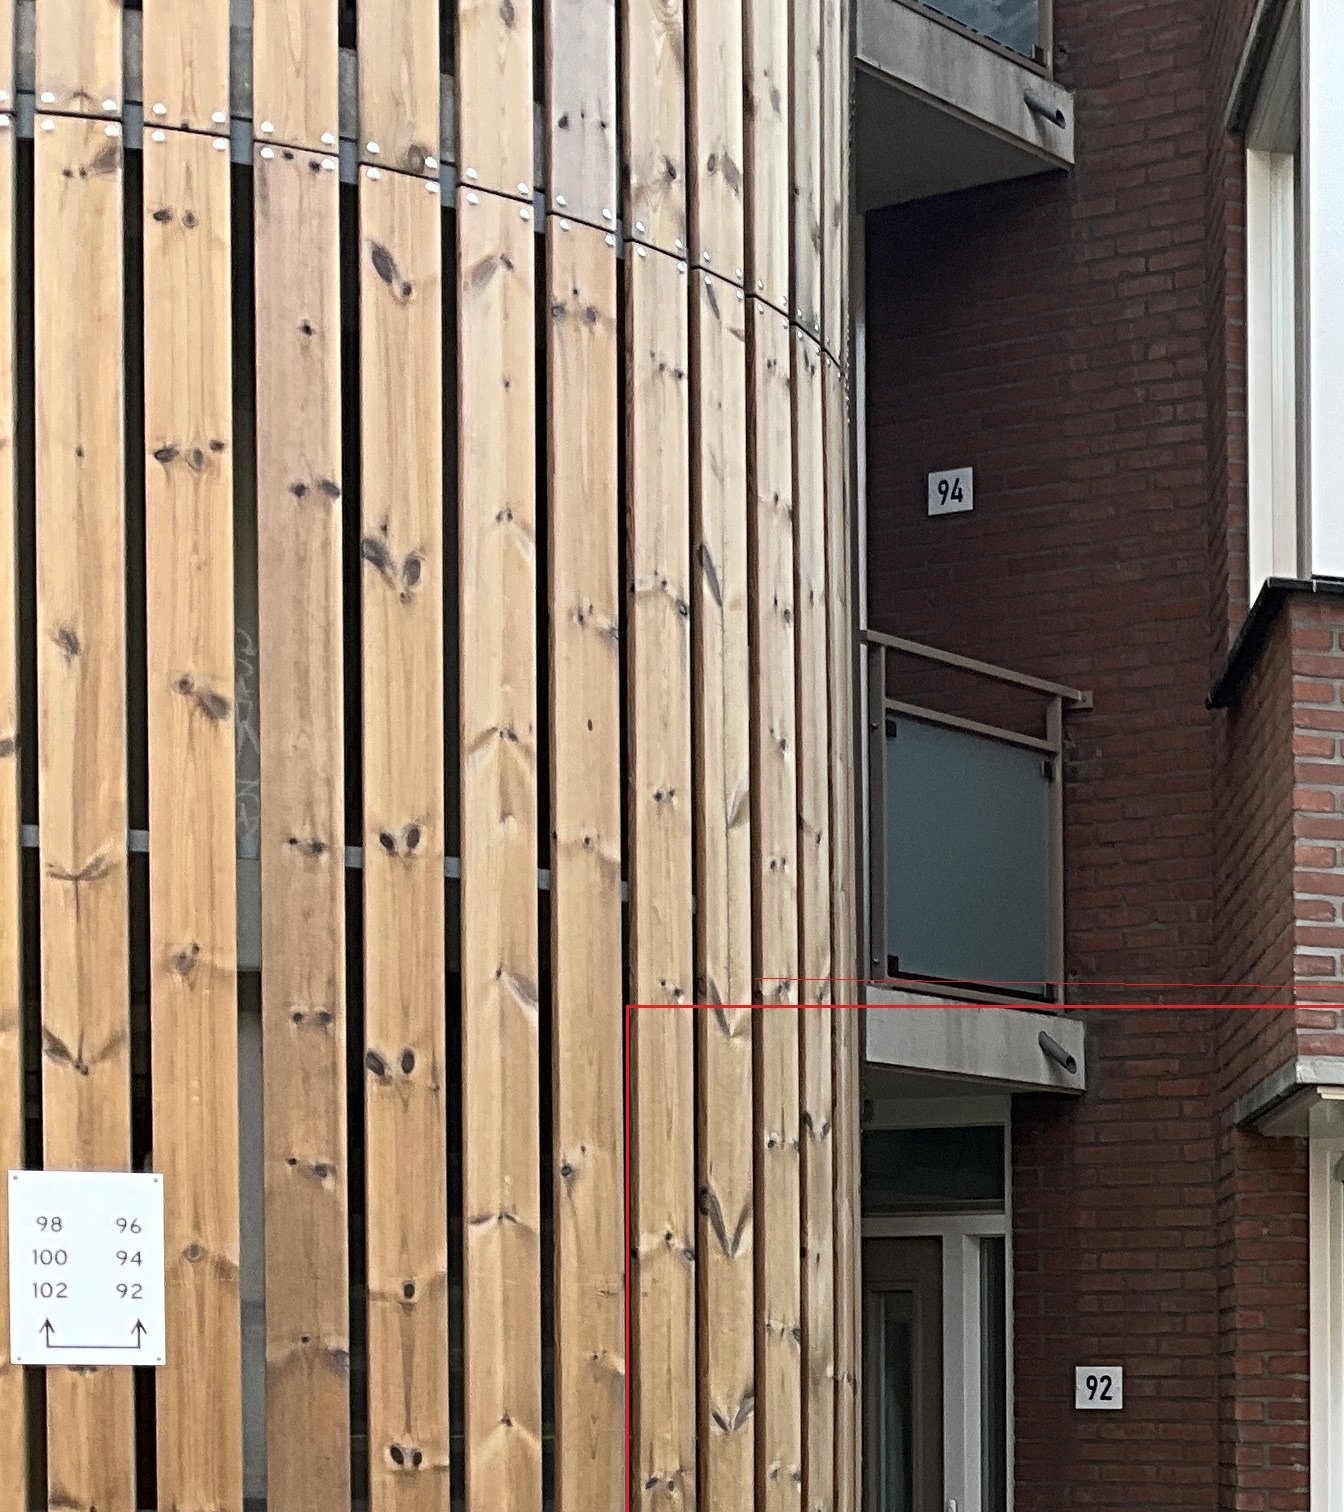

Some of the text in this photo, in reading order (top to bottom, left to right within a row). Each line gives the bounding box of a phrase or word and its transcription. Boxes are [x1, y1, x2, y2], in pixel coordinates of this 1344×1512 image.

[937, 477, 963, 506] 94
[36, 1216, 63, 1233] 98
[115, 1217, 142, 1234] 96
[32, 1249, 68, 1266] 100
[115, 1250, 143, 1267] 94
[32, 1282, 69, 1299] 102
[116, 1283, 143, 1300] 92
[1086, 1374, 1112, 1401] 92
